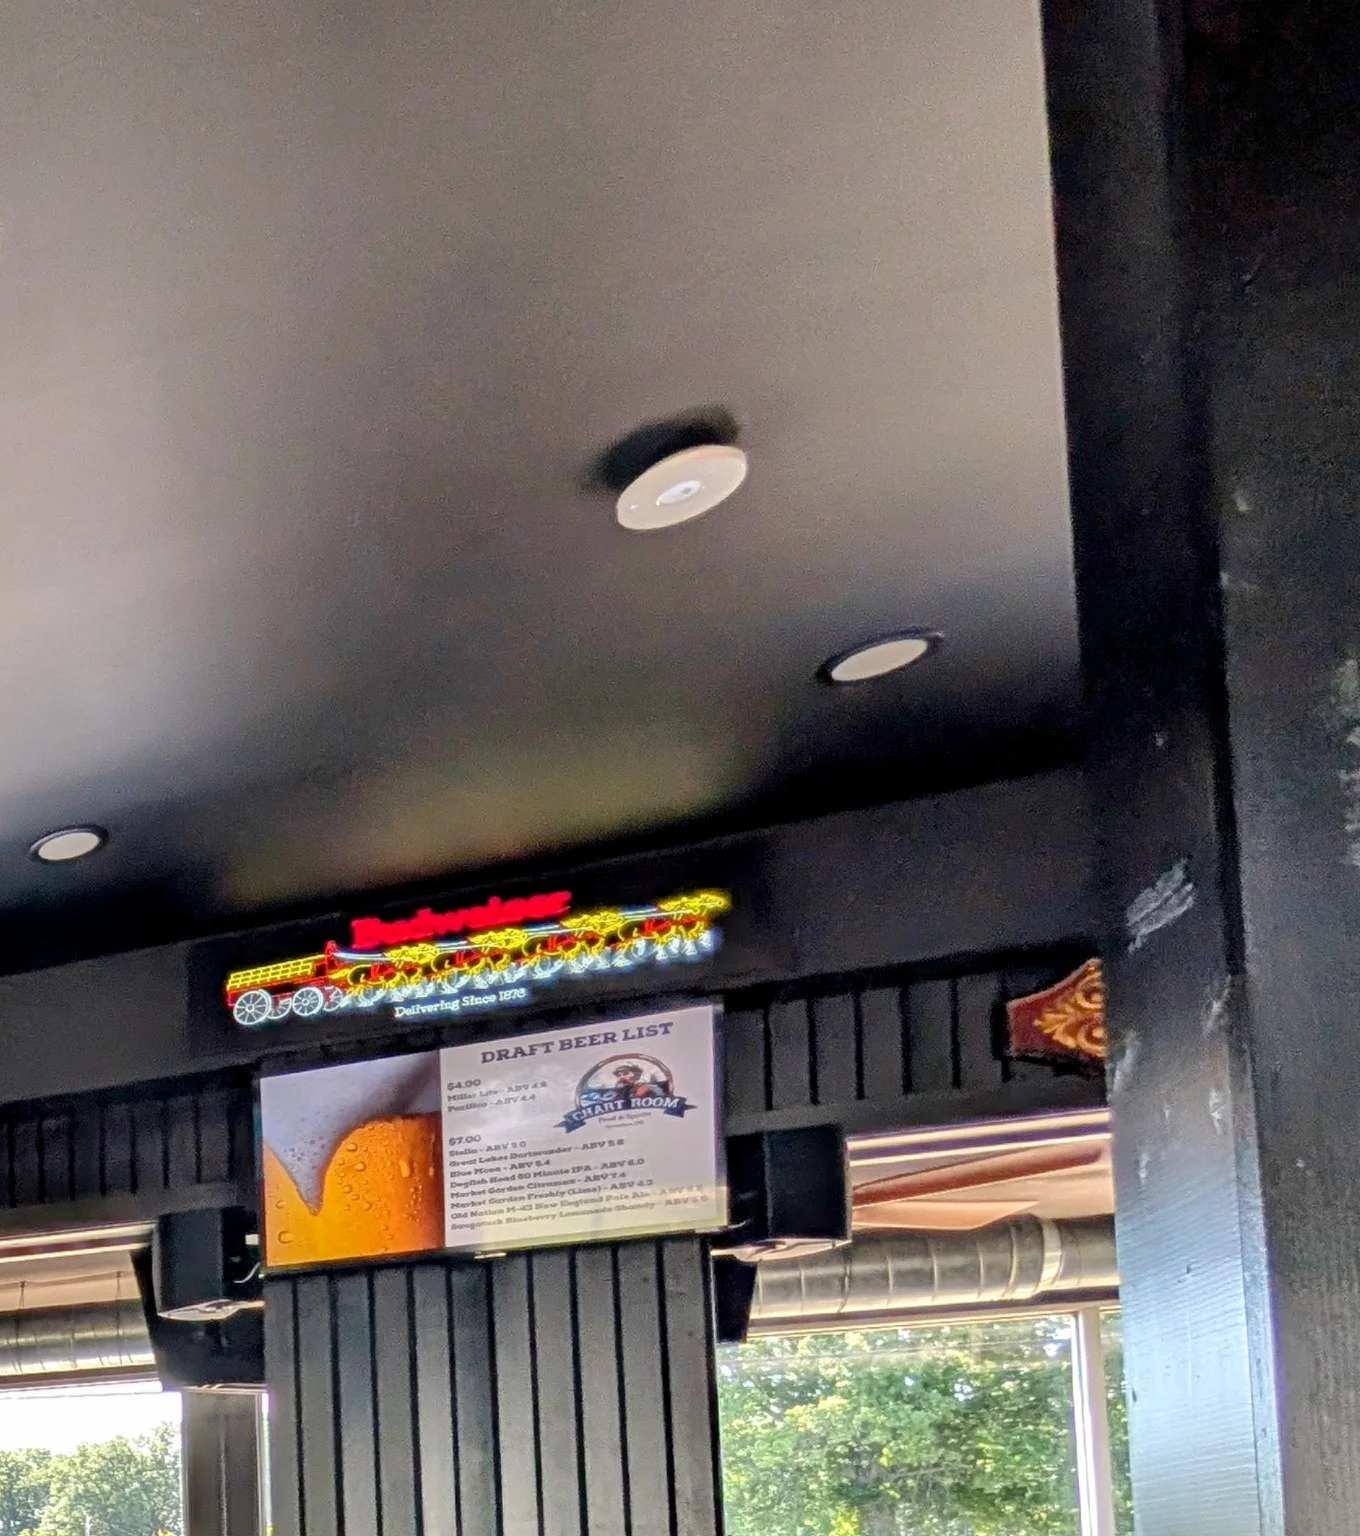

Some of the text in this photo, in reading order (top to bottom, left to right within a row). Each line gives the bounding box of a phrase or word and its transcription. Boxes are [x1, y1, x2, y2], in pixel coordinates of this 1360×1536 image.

[394, 998, 460, 1018] Delivering
[461, 994, 497, 1007] Since
[480, 1021, 673, 1063] DRAFT BEER LIST
[447, 1078, 480, 1091] $4.00
[506, 1084, 527, 1093] ABV
[572, 1096, 678, 1121] CHART ROOM
[448, 1133, 481, 1146] $7.00
[485, 1142, 508, 1152] ABV
[449, 1156, 482, 1167] Great
[483, 1153, 507, 1163] Lakes
[581, 1140, 605, 1151] ABV
[449, 1168, 471, 1178] Blue
[474, 1164, 500, 1175] Moon
[509, 1160, 533, 1170] ABV
[450, 1177, 486, 1189] Dogfish
[489, 1173, 515, 1184] Head
[536, 1167, 569, 1178] Minute
[571, 1164, 591, 1174] IPA
[600, 1160, 626, 1170] ABV
[450, 1188, 485, 1199] Market
[488, 1183, 523, 1194] Garden
[583, 1173, 608, 1183] ABV
[450, 1198, 485, 1210] Market
[488, 1194, 523, 1205] Garden
[610, 1181, 634, 1191] ABV
[451, 1211, 468, 1220] Old
[471, 1207, 503, 1218] Nation
[535, 1200, 558, 1211] New
[560, 1195, 603, 1208] England
[605, 1192, 630, 1202] Pale
[505, 1211, 557, 1225] Blueberry
[559, 1205, 612, 1218] Lemonade
[615, 1200, 655, 1212] Shandy
